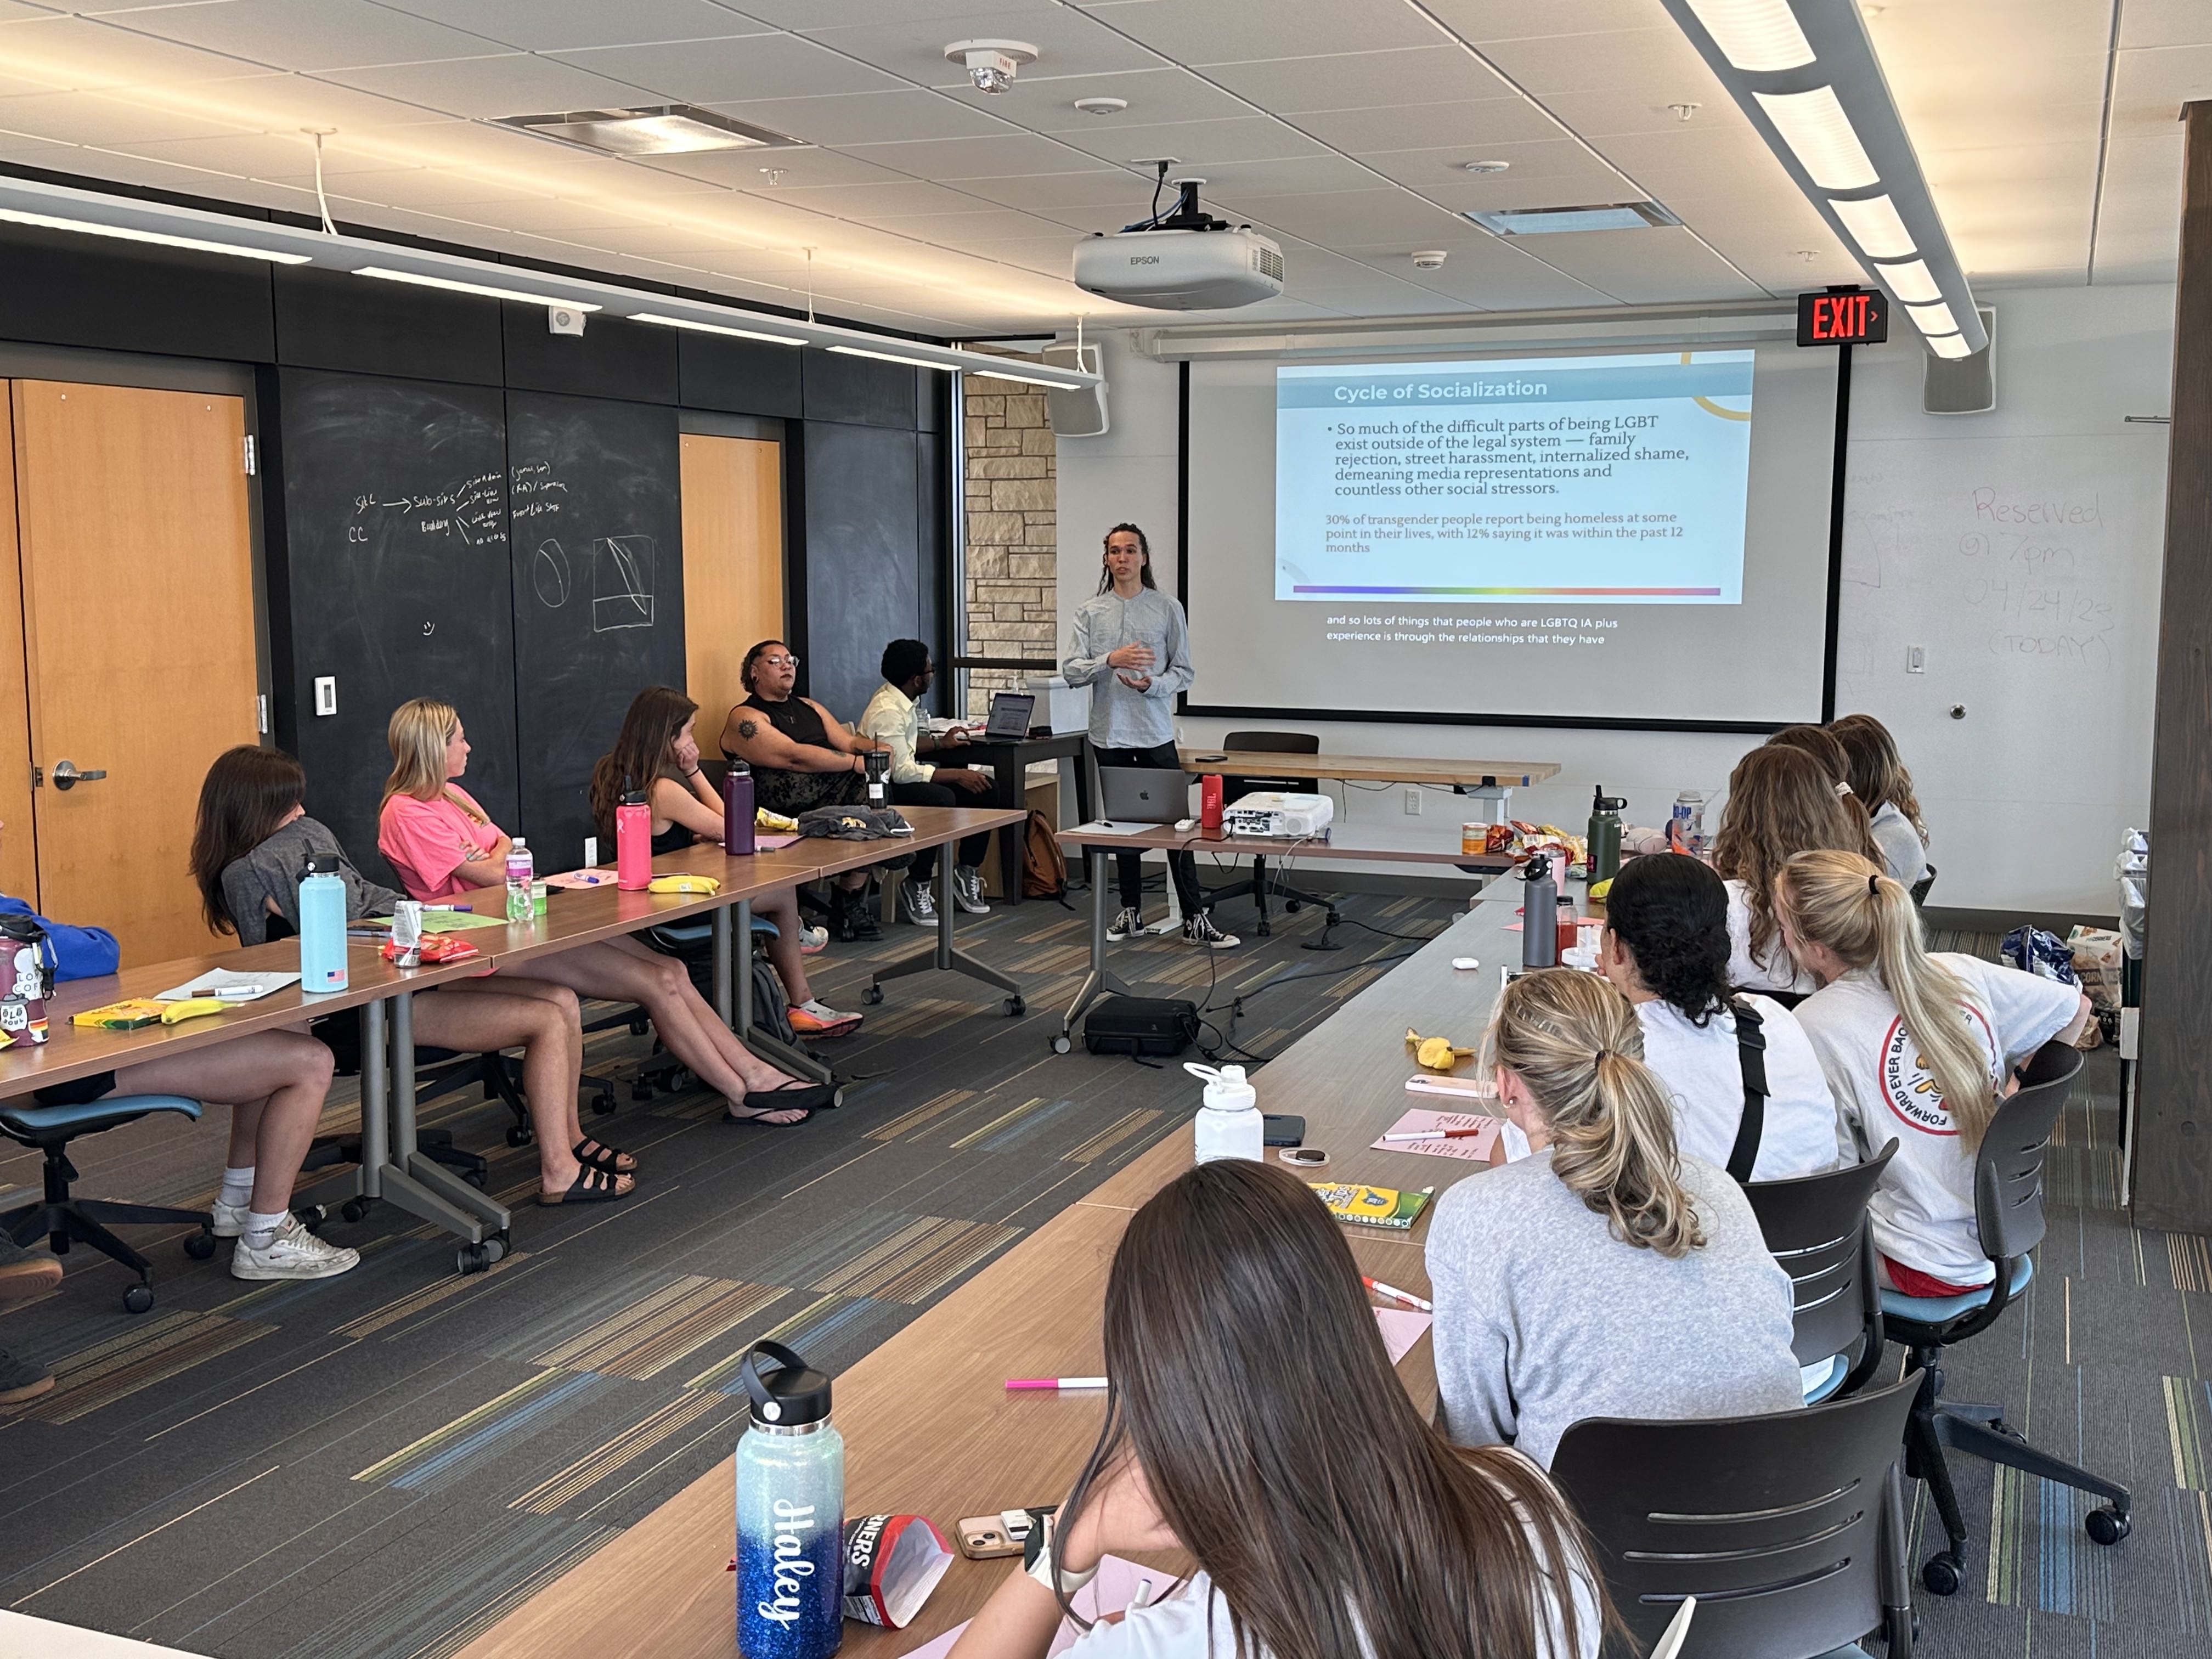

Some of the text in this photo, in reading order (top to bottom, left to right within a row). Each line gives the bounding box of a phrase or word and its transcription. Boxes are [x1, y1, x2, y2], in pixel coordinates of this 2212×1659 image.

[1000, 58, 1011, 70] FIRE
[1130, 256, 1160, 266] EPSON
[1813, 296, 1870, 339] EXIT
[1334, 380, 1548, 403] Cycle of Socialization
[1337, 415, 1658, 436] So much of the difficult parts of being LGBT
[1335, 437, 1368, 450] exist
[1372, 436, 1424, 449] outside
[1427, 436, 1443, 449] of
[1446, 436, 1469, 448] the
[1473, 435, 1506, 451] legal
[1510, 437, 1561, 450] system
[1589, 432, 1636, 448] family
[1335, 447, 1689, 469] rejection, street harassment, internalized shame,
[1335, 464, 1612, 483] demeaning media representations and
[1335, 482, 1560, 495] countless other social stressors.
[1972, 487, 2103, 528] Reserved
[1326, 512, 1677, 527] 30% of transgender people report being homeless at some
[1326, 527, 1683, 541] point in their lives, with 12% saying it was within the past 12
[1326, 543, 1370, 552] months
[1959, 532, 1990, 556] @
[1962, 578, 2115, 631] 04/24/23
[1327, 615, 1346, 624] and
[1363, 615, 1381, 625] lots
[1385, 616, 1396, 625] of
[1398, 616, 1429, 628] things
[1433, 616, 1453, 626] that
[1456, 616, 1492, 628] people
[1495, 617, 1517, 627] who
[1541, 618, 1578, 628] LGBTQ
[1581, 618, 1592, 628] IA
[1595, 618, 1618, 629] plus
[1327, 632, 1604, 645] experience is through the relationships that they have
[1988, 630, 2111, 673] (TODAY)
[1206, 793, 1217, 810] JBL
[3, 1007, 22, 1019] OLD
[1888, 1056, 1901, 1090] EVER
[1895, 1090, 1947, 1126] FORWARD
[758, 1499, 815, 1631] Haley
